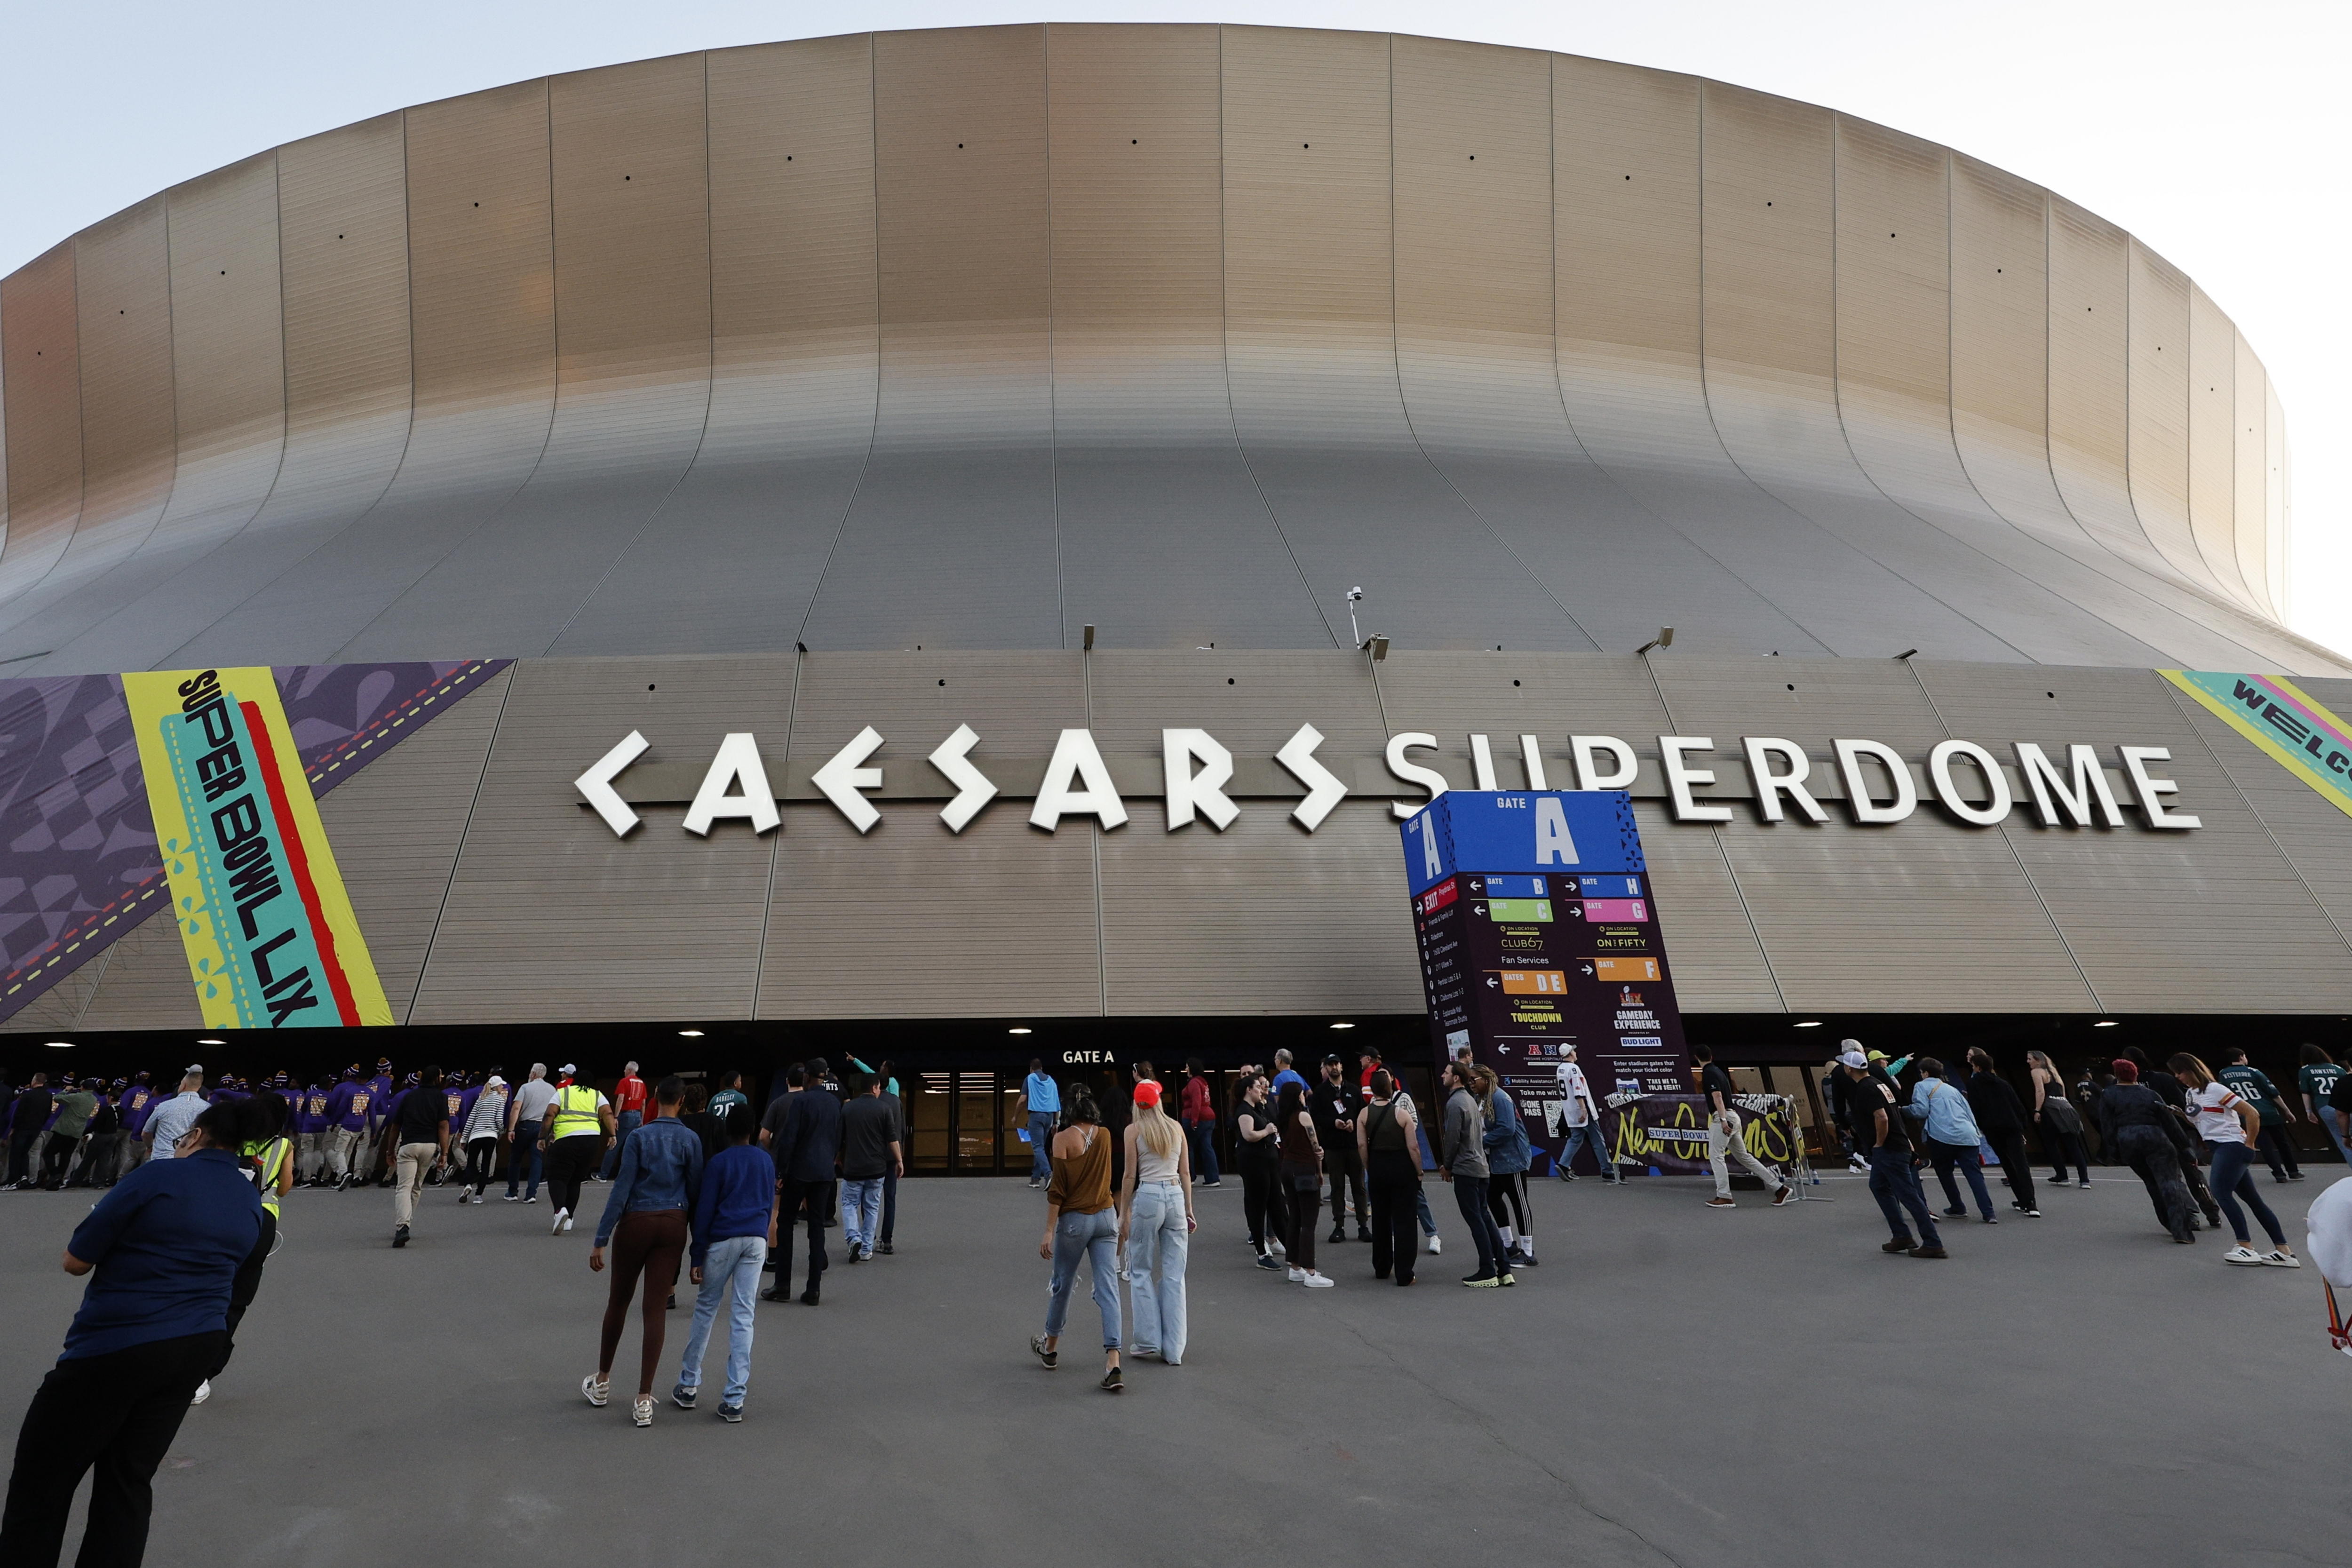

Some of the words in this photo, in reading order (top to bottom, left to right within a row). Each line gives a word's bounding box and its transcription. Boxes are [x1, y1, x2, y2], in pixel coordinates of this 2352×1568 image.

[178, 669, 246, 803] SUPER
[2233, 679, 2352, 783] WELC
[573, 722, 1349, 838] CAESARS
[1497, 797, 1526, 809] GATE
[1535, 797, 1580, 864] A
[1408, 819, 1419, 834] GATE
[1422, 810, 1442, 880] A
[210, 793, 282, 942] BOWL
[1533, 878, 1543, 894] B
[1626, 878, 1638, 894] H
[1425, 891, 1438, 911] EXIT
[1537, 902, 1547, 919] C
[1632, 902, 1644, 919] G
[1501, 937, 1543, 950] CLUB67
[251, 928, 318, 1028] LIX
[1645, 961, 1654, 978] F
[1536, 974, 1547, 991] D
[1550, 974, 1561, 991] E
[1510, 1012, 1562, 1022] TOUCHDOWN
[1616, 1011, 1653, 1019] GAMEDAY
[1613, 1020, 1661, 1029] EXPERIENCE
[1063, 1051, 1100, 1063] GATE
[1104, 1051, 1114, 1063] A
[1559, 1079, 1568, 1100] 9
[2230, 1082, 2262, 1100] 36
[1649, 1130, 1680, 1138] SUPER
